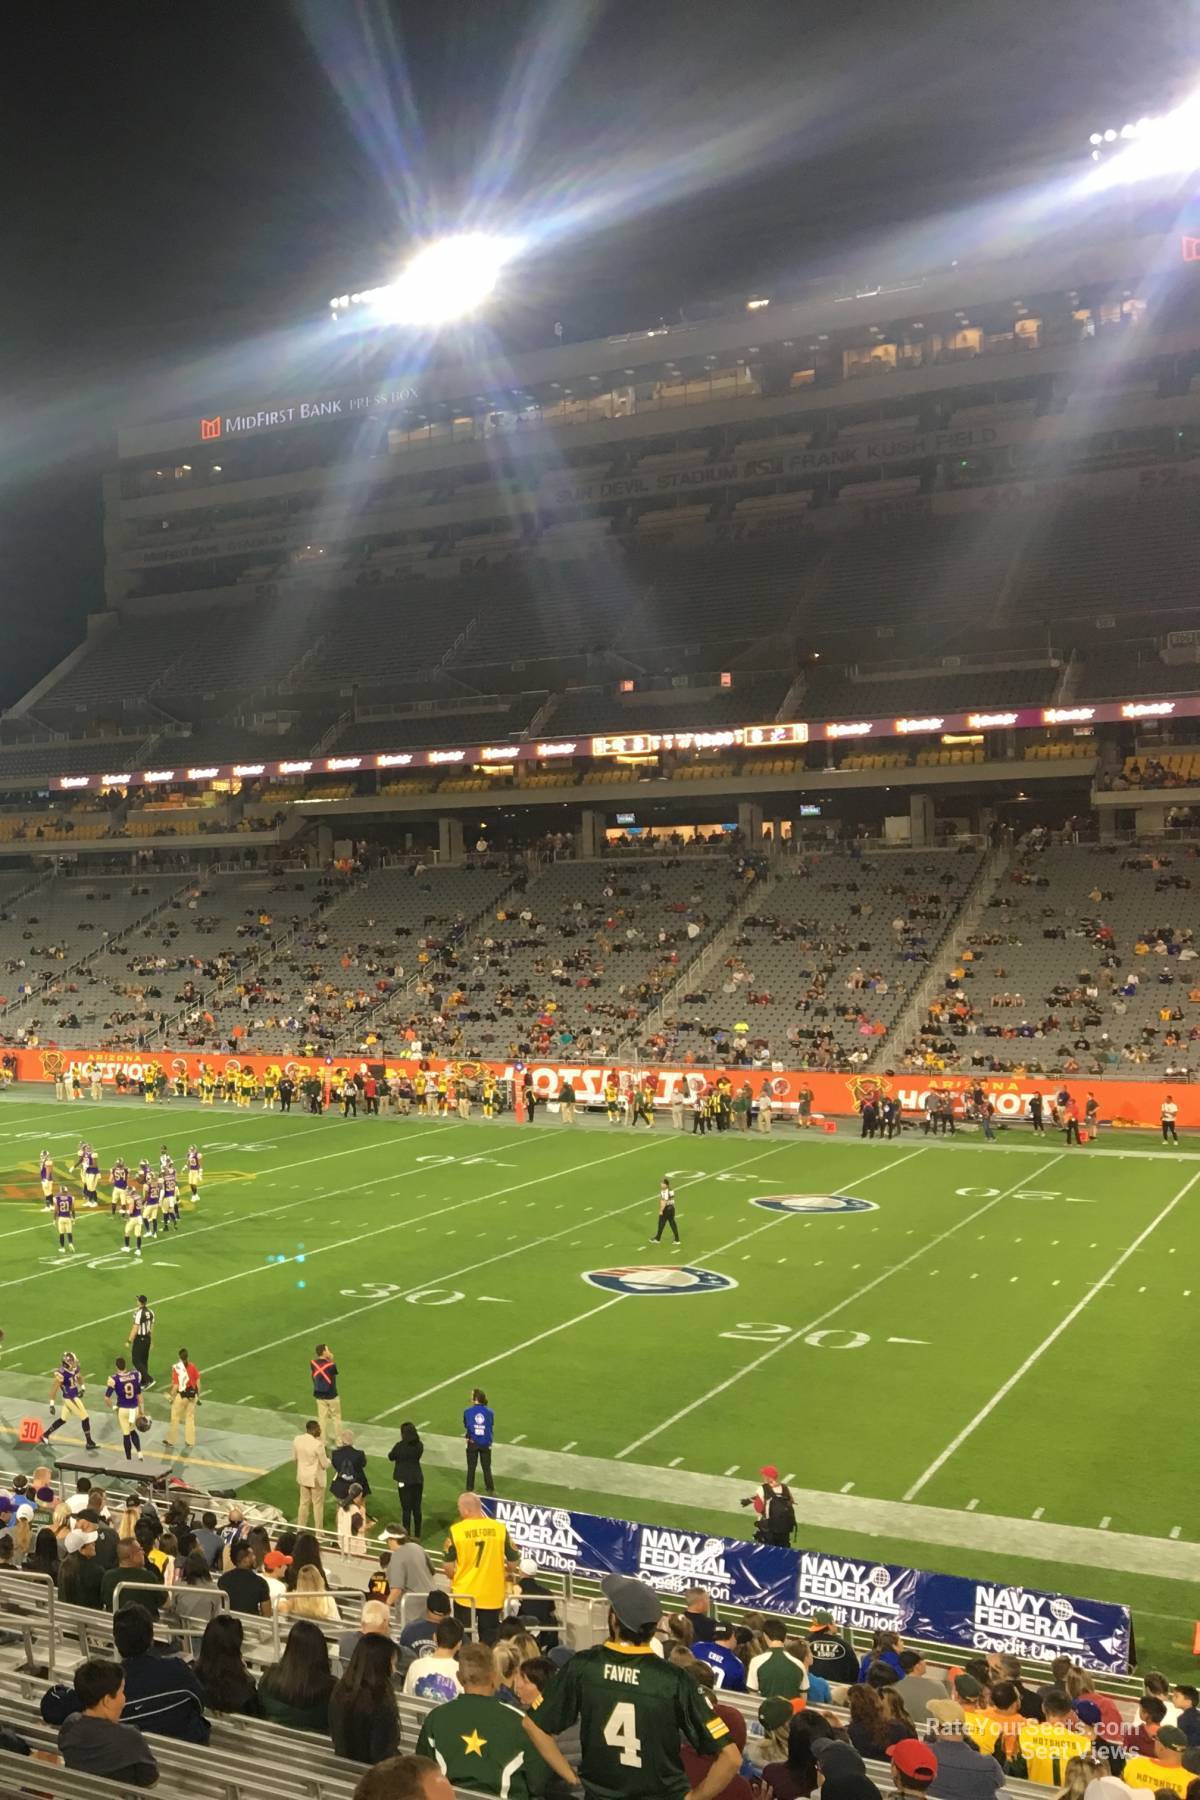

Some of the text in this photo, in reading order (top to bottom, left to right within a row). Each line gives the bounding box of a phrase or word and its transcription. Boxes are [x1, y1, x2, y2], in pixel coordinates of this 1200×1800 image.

[657, 466, 738, 489] STADIUM
[790, 449, 856, 469] FRANK
[339, 1282, 466, 1306] 30
[718, 1322, 871, 1349] 20
[123, 1382, 135, 1400] 9
[21, 1421, 38, 1442] 30
[495, 1502, 550, 1526] NAVY
[642, 1528, 700, 1552] NAVY
[474, 1541, 486, 1568] 7
[535, 1549, 577, 1572] Union
[640, 1549, 731, 1578] FEDERAL
[801, 1554, 865, 1583] NAVY
[800, 1575, 900, 1609] FEDERAL
[975, 1586, 1043, 1614] NAVY
[851, 1609, 902, 1633] Union
[974, 1609, 1084, 1645] FEDERAL
[708, 1651, 725, 1664] CRUZ
[813, 1643, 839, 1653] FITZ
[973, 1633, 1084, 1667] Credit Union
[604, 1663, 640, 1686] FAVRE
[604, 1702, 642, 1768] 4
[1137, 1772, 1183, 1792] HOTSHOTS
